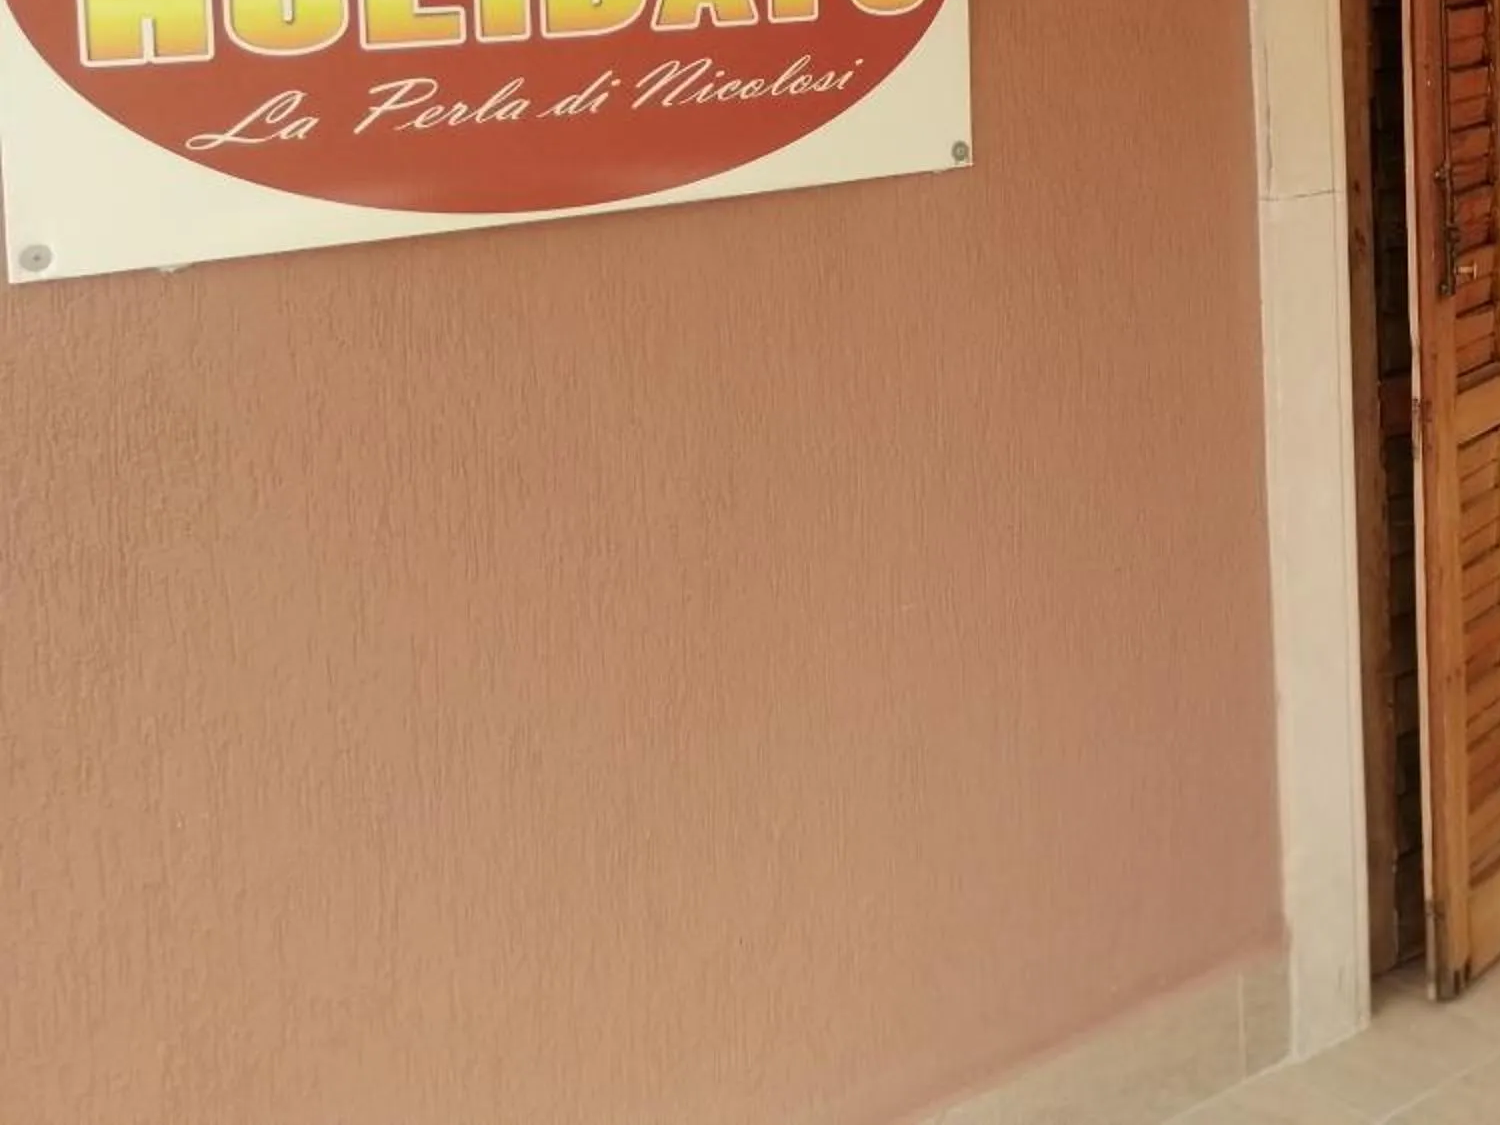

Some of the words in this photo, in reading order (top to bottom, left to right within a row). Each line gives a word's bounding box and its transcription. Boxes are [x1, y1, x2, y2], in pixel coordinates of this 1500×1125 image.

[186, 90, 318, 151] La
[354, 77, 531, 134] Perla
[537, 69, 616, 118] di
[633, 55, 864, 109] Nicolosi
